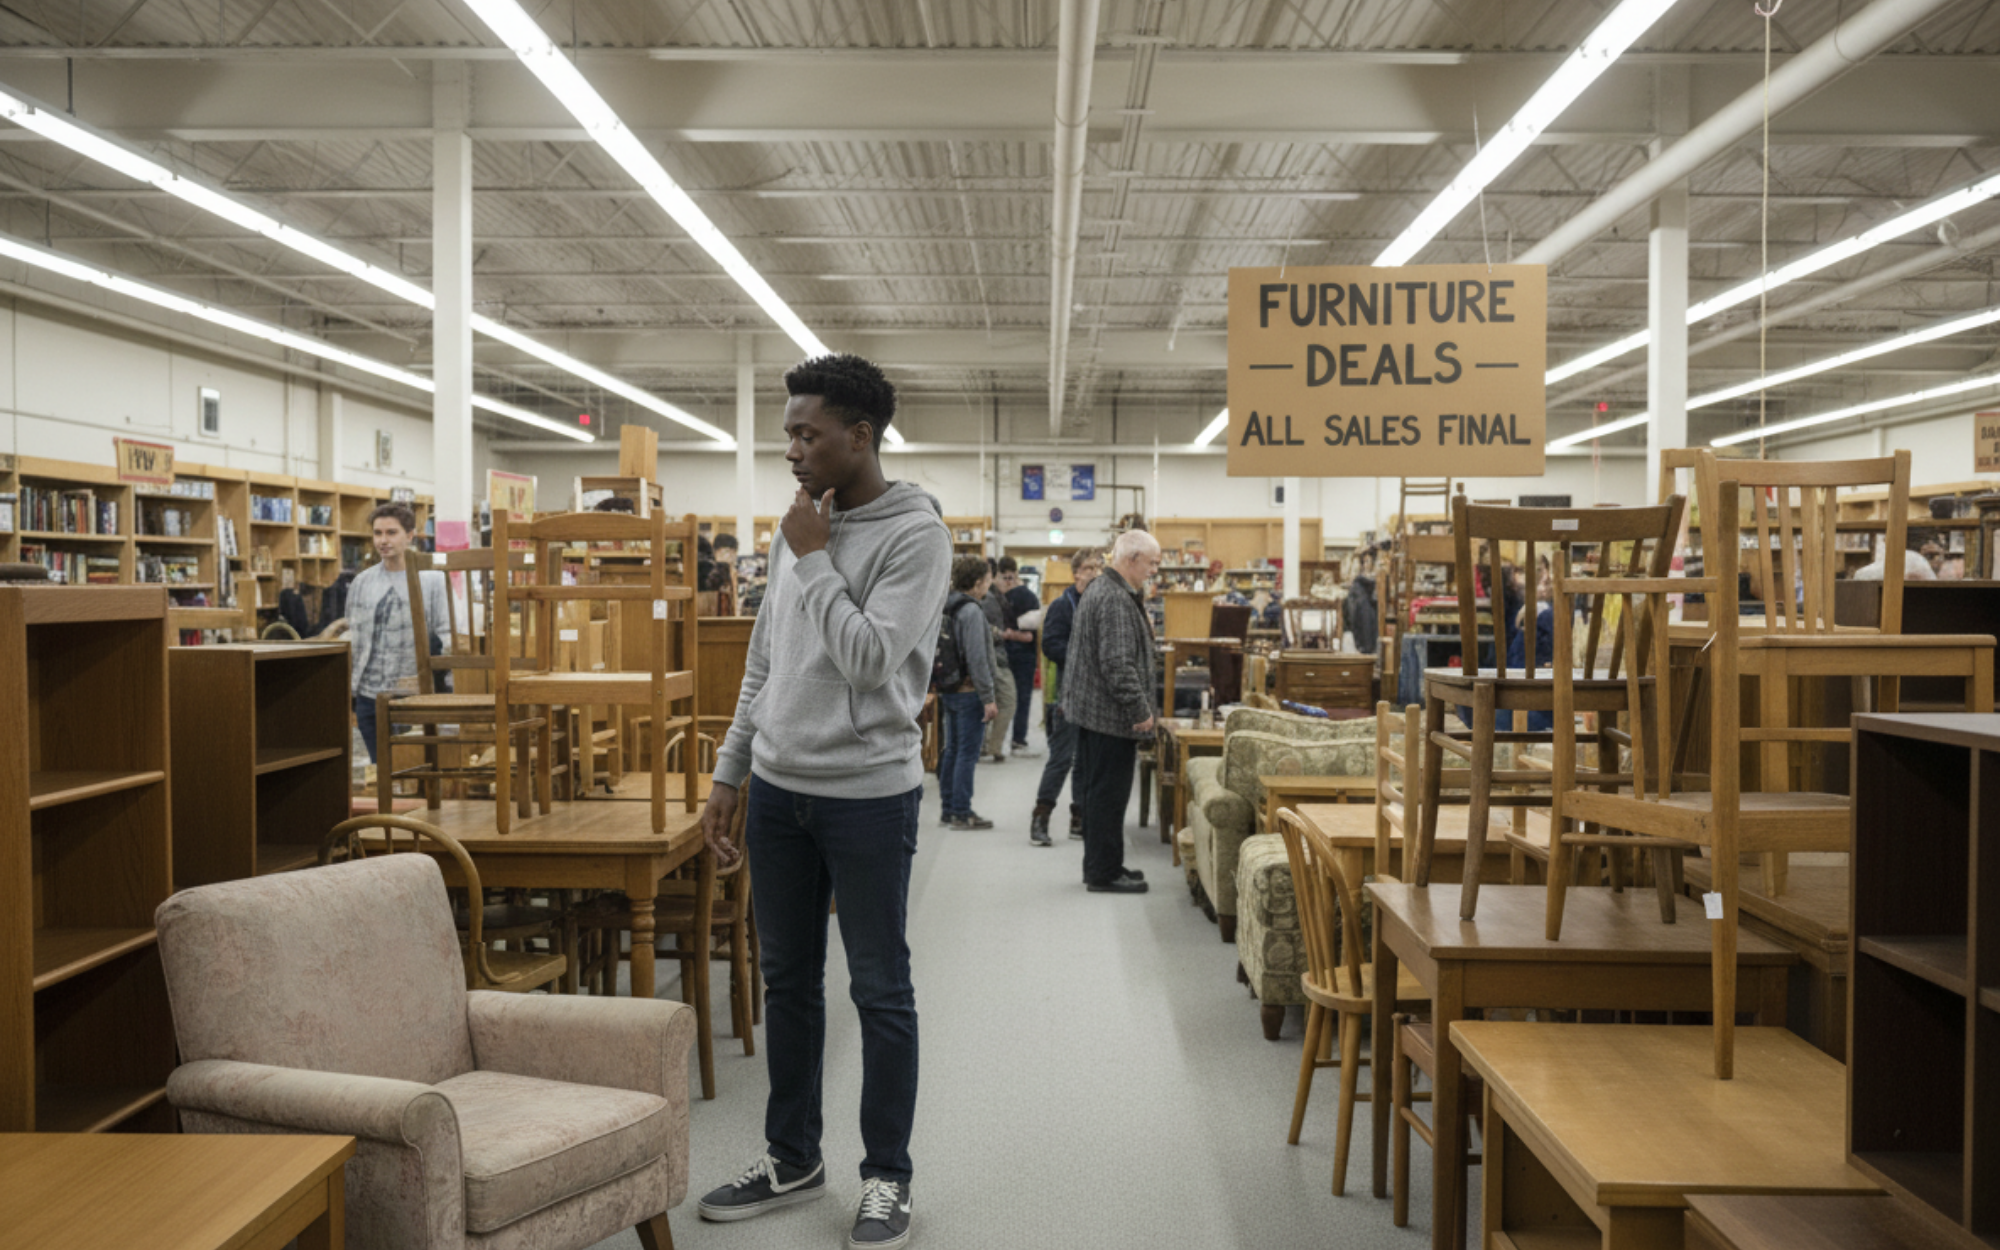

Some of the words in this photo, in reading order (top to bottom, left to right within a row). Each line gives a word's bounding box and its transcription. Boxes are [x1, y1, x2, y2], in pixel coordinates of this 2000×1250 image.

[1260, 281, 1514, 328] FURNITURE
[1307, 342, 1461, 387] DEALS
[1240, 411, 1304, 446] ALL
[1324, 415, 1421, 446] SALES
[1439, 414, 1531, 445] FINAL
